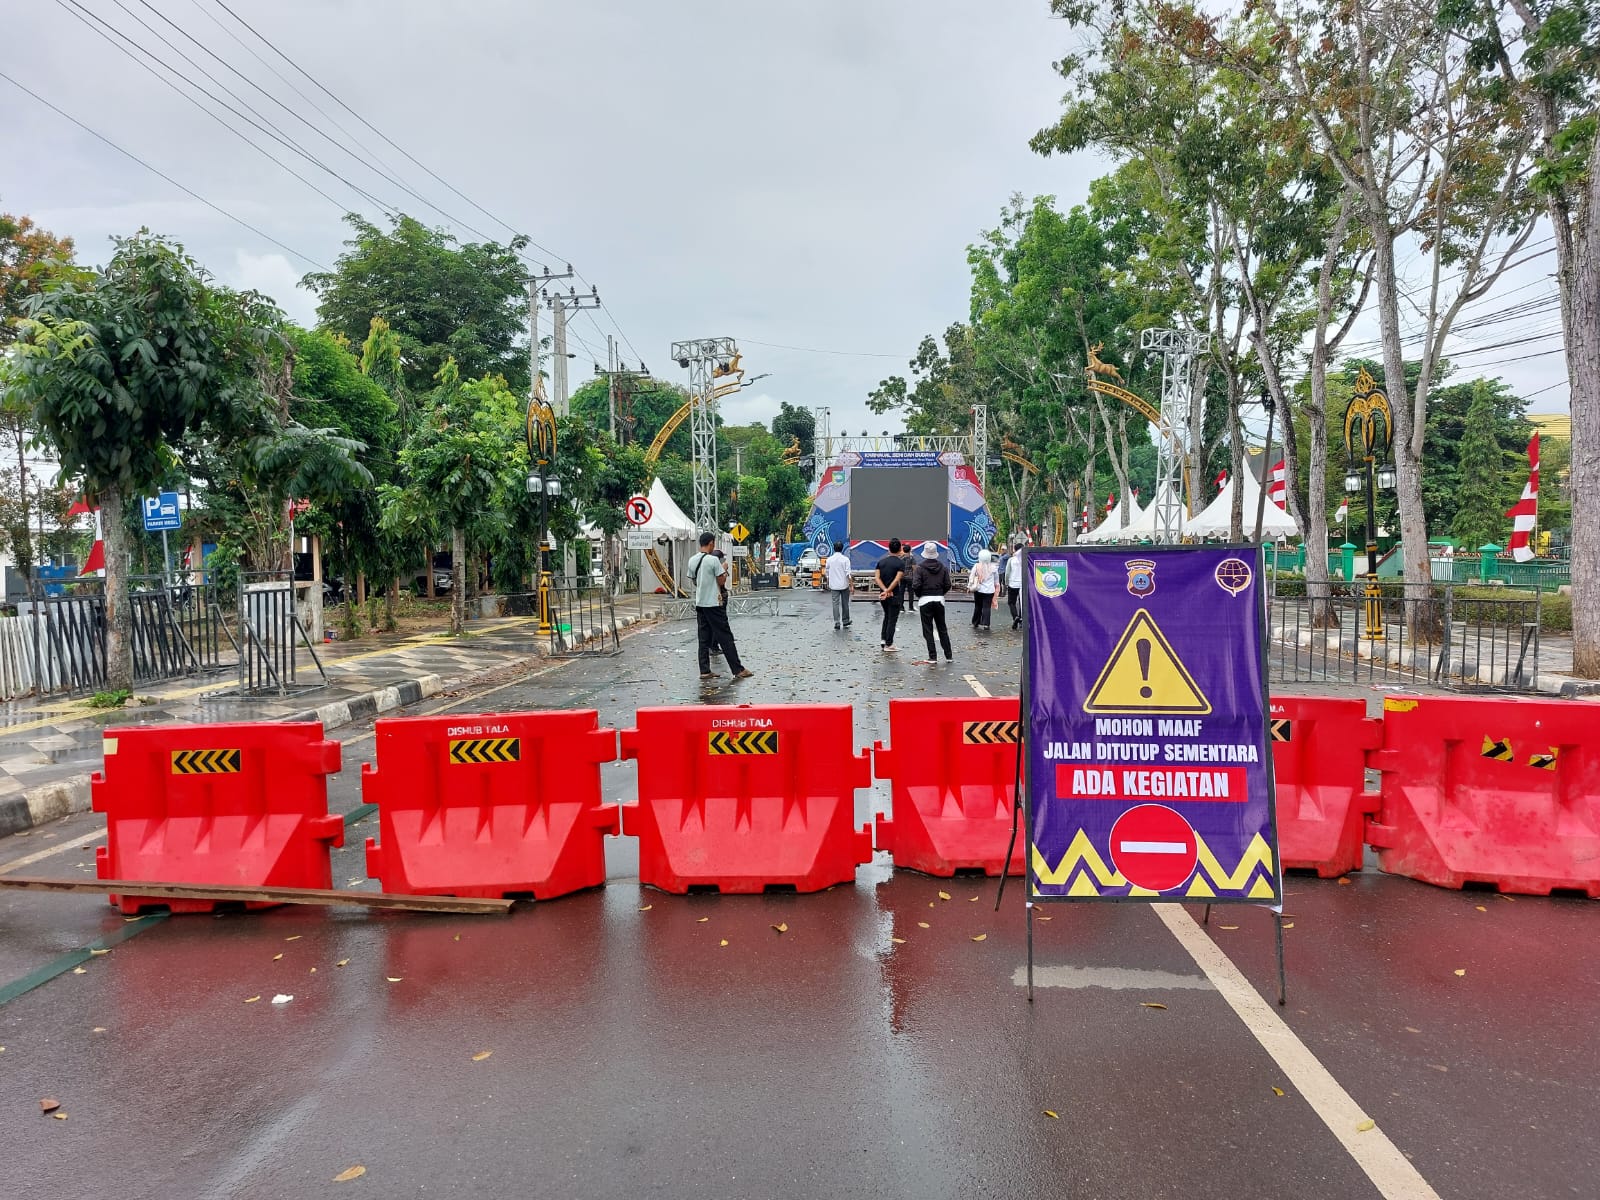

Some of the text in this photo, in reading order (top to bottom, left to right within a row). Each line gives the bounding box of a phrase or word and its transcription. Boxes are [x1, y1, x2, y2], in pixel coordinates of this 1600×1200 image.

[145, 496, 161, 518] P
[447, 725, 483, 737] DISHUB
[712, 718, 773, 728] DISHUB TALA
[1096, 718, 1202, 737] MOHON MAAF
[1044, 742, 1259, 763] JALAN DITUTUP SEMENTARA
[1072, 769, 1229, 798] ADA KEGIATAN
